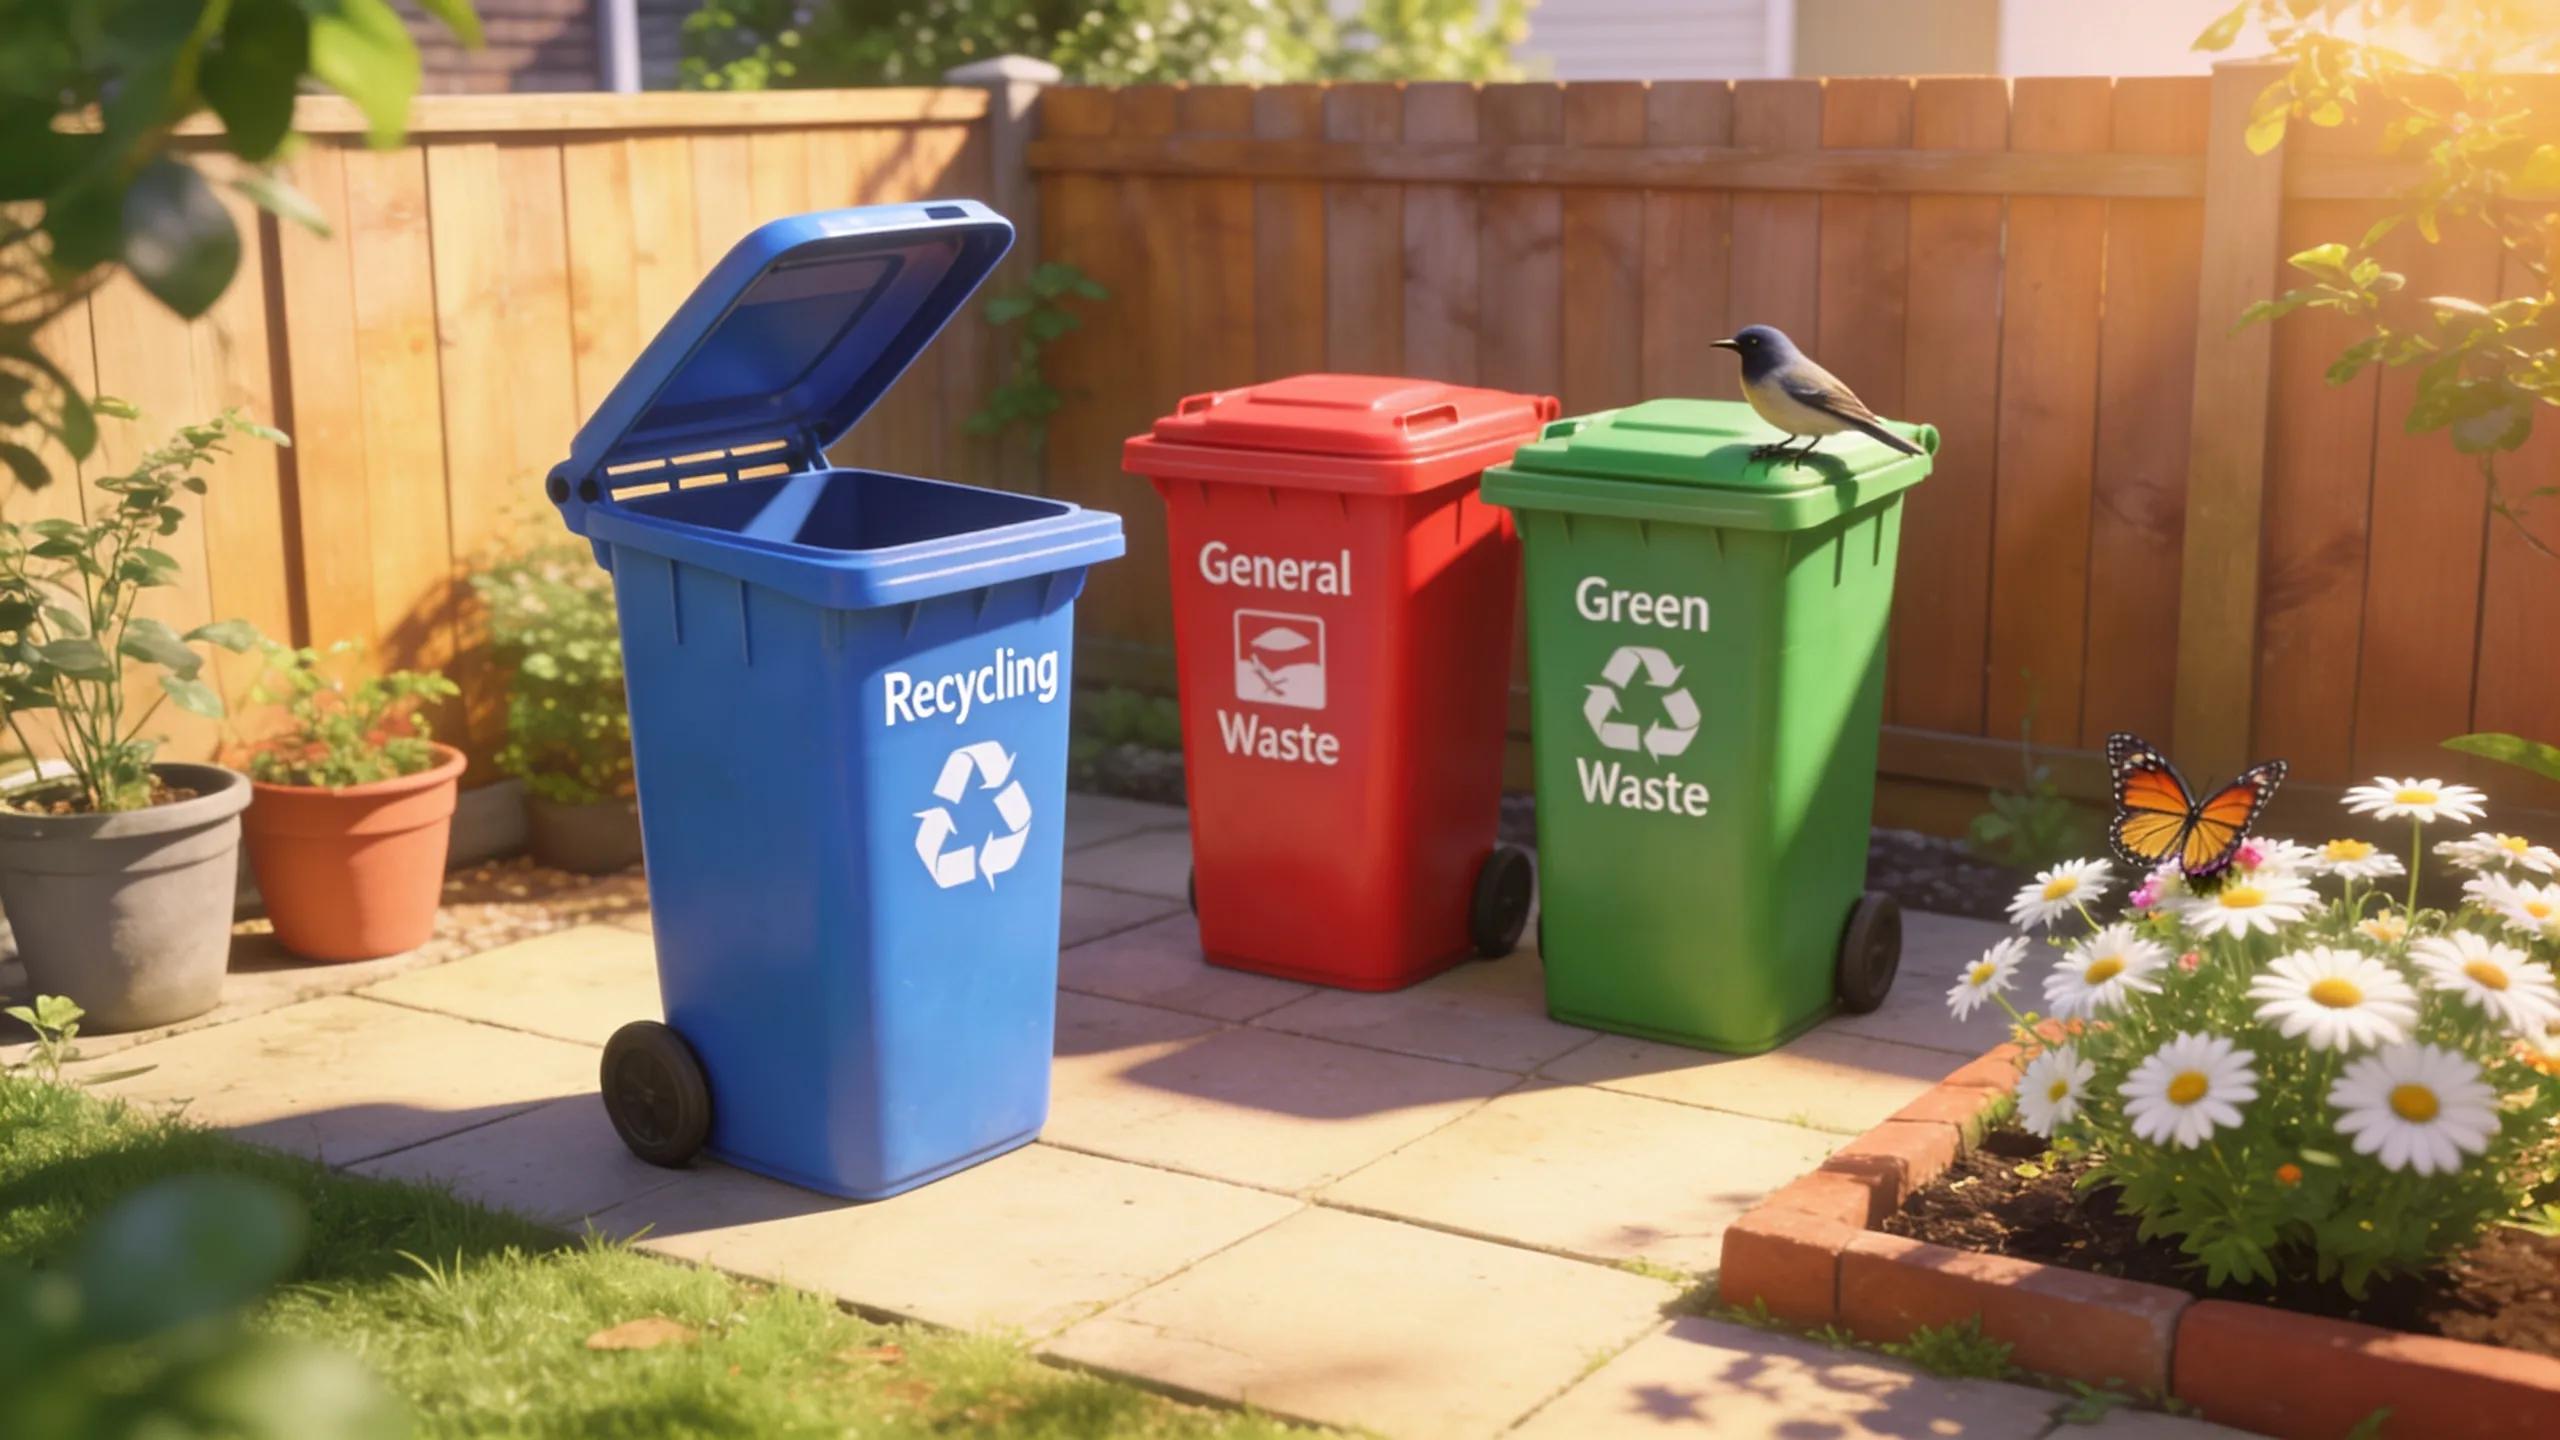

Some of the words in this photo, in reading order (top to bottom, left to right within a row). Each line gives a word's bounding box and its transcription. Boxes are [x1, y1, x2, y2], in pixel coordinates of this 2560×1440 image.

[1199, 541, 1351, 596] General
[1575, 576, 1709, 632] Green
[884, 647, 1058, 726] Recycling
[1217, 709, 1340, 765] Waste
[1576, 757, 1710, 816] Waste
